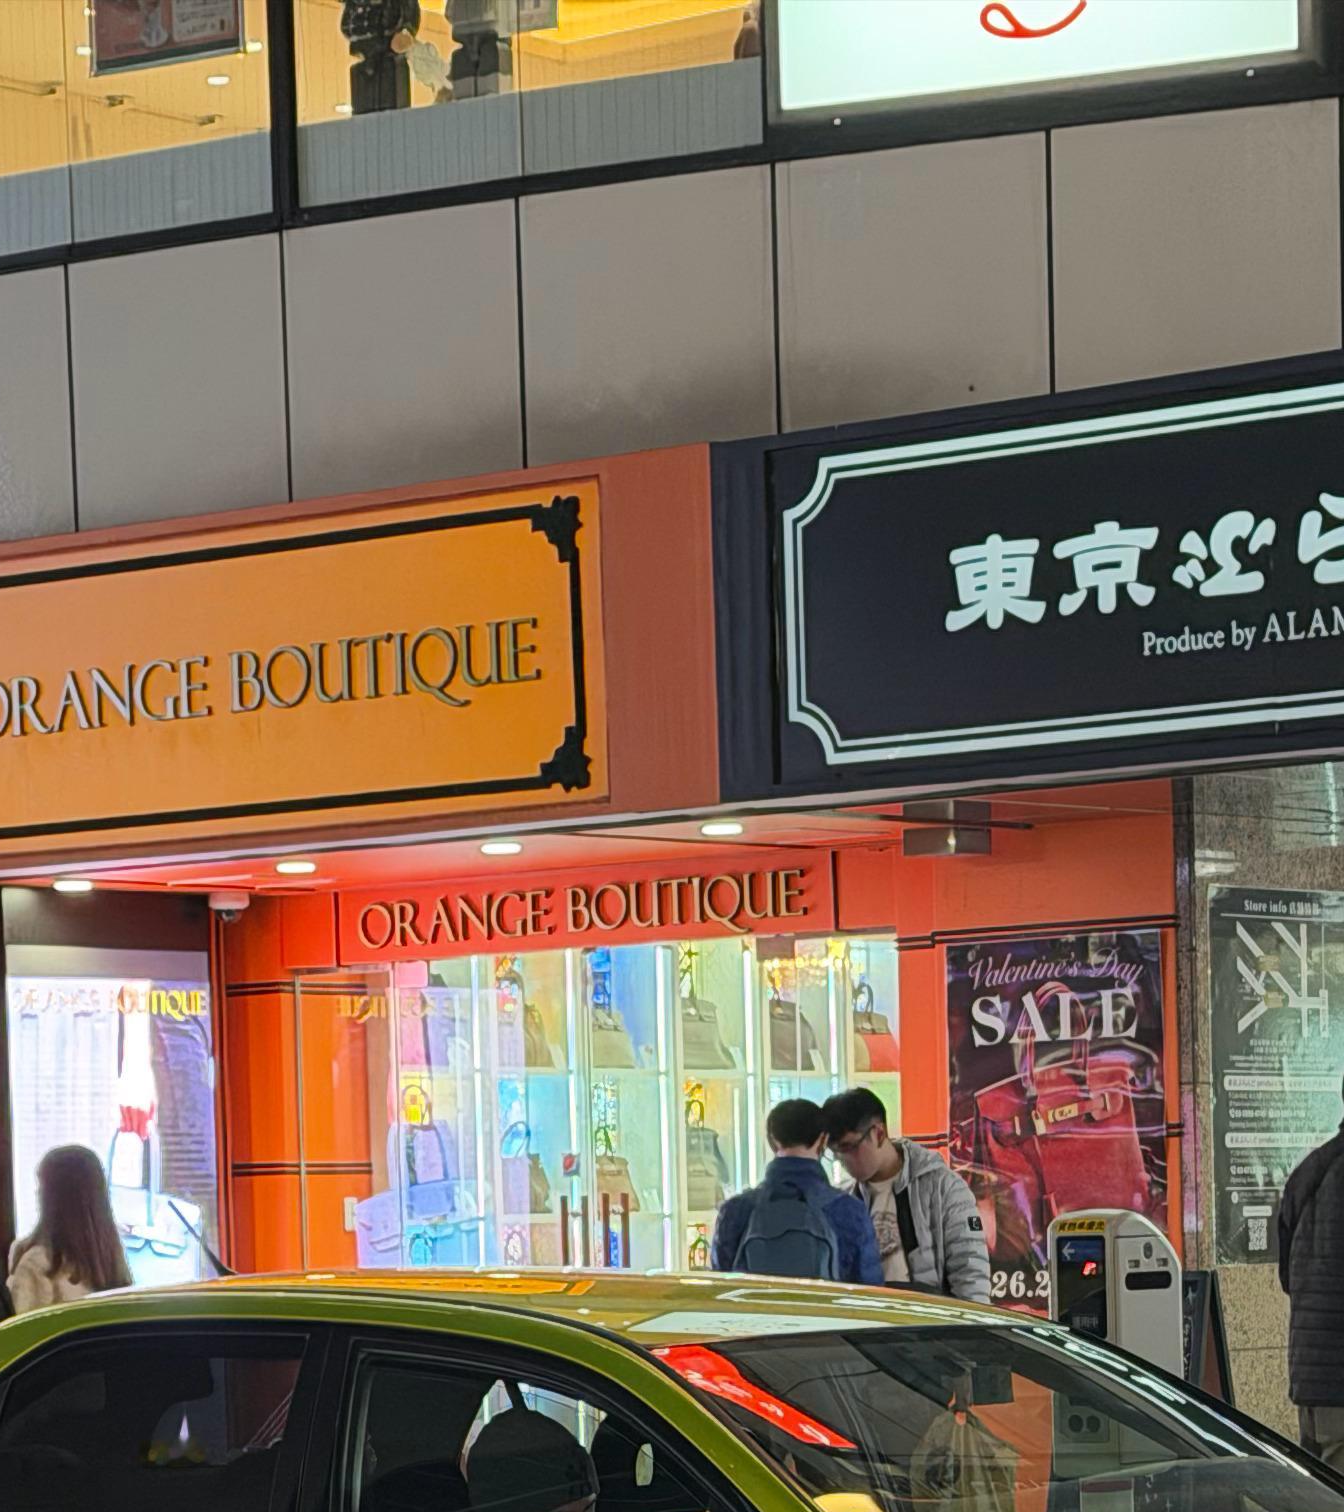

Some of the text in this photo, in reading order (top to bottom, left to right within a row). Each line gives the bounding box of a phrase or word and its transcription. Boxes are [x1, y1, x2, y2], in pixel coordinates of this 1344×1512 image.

[228, 616, 543, 713] BOUTIQUE
[1142, 619, 1225, 657] Produce
[1230, 620, 1257, 651] by
[359, 868, 808, 950] ORANGE BOUTIQUE
[1244, 900, 1267, 912] Store
[1269, 901, 1288, 914] info
[969, 946, 1143, 991] Valentine's Day
[971, 987, 1138, 1049] SALE
